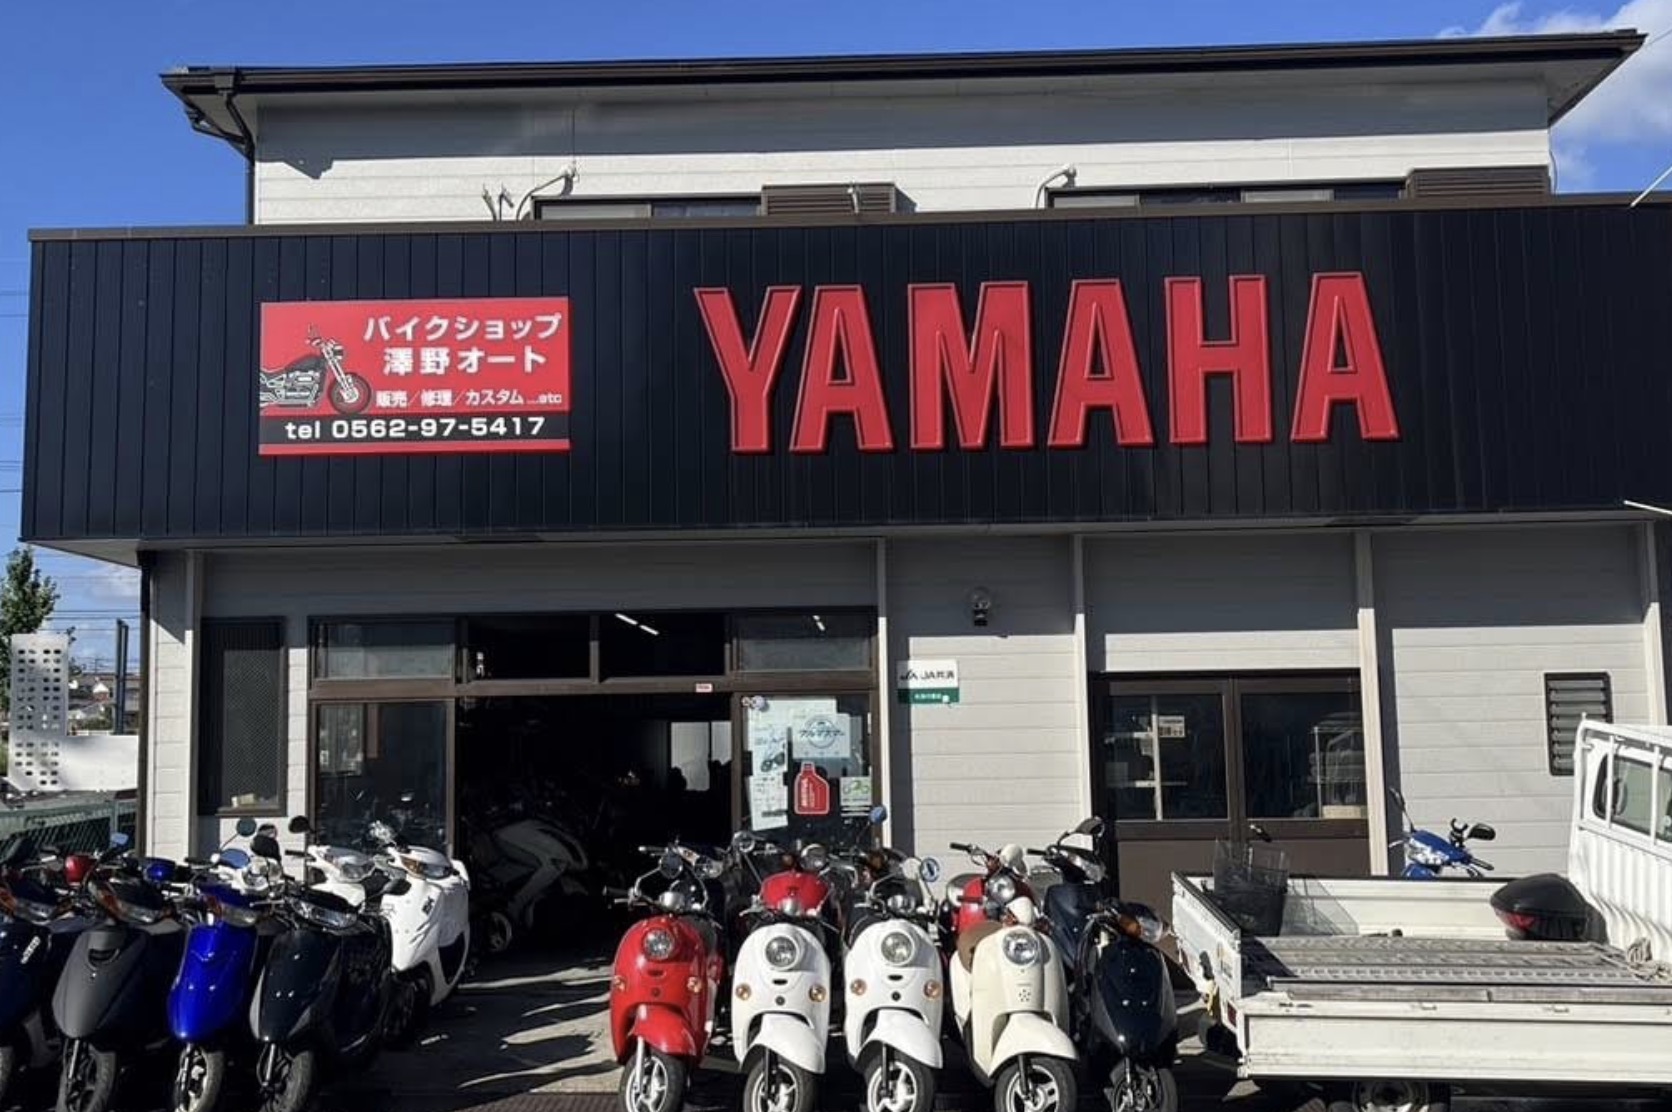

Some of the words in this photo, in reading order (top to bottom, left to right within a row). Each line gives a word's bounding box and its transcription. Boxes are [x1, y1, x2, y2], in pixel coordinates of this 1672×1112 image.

[363, 312, 562, 341] バイクショップ
[383, 345, 547, 375] 澤野オート
[694, 272, 1399, 453] YAMAHA
[284, 420, 320, 439] tel
[332, 417, 546, 438] 0562-97-5417
